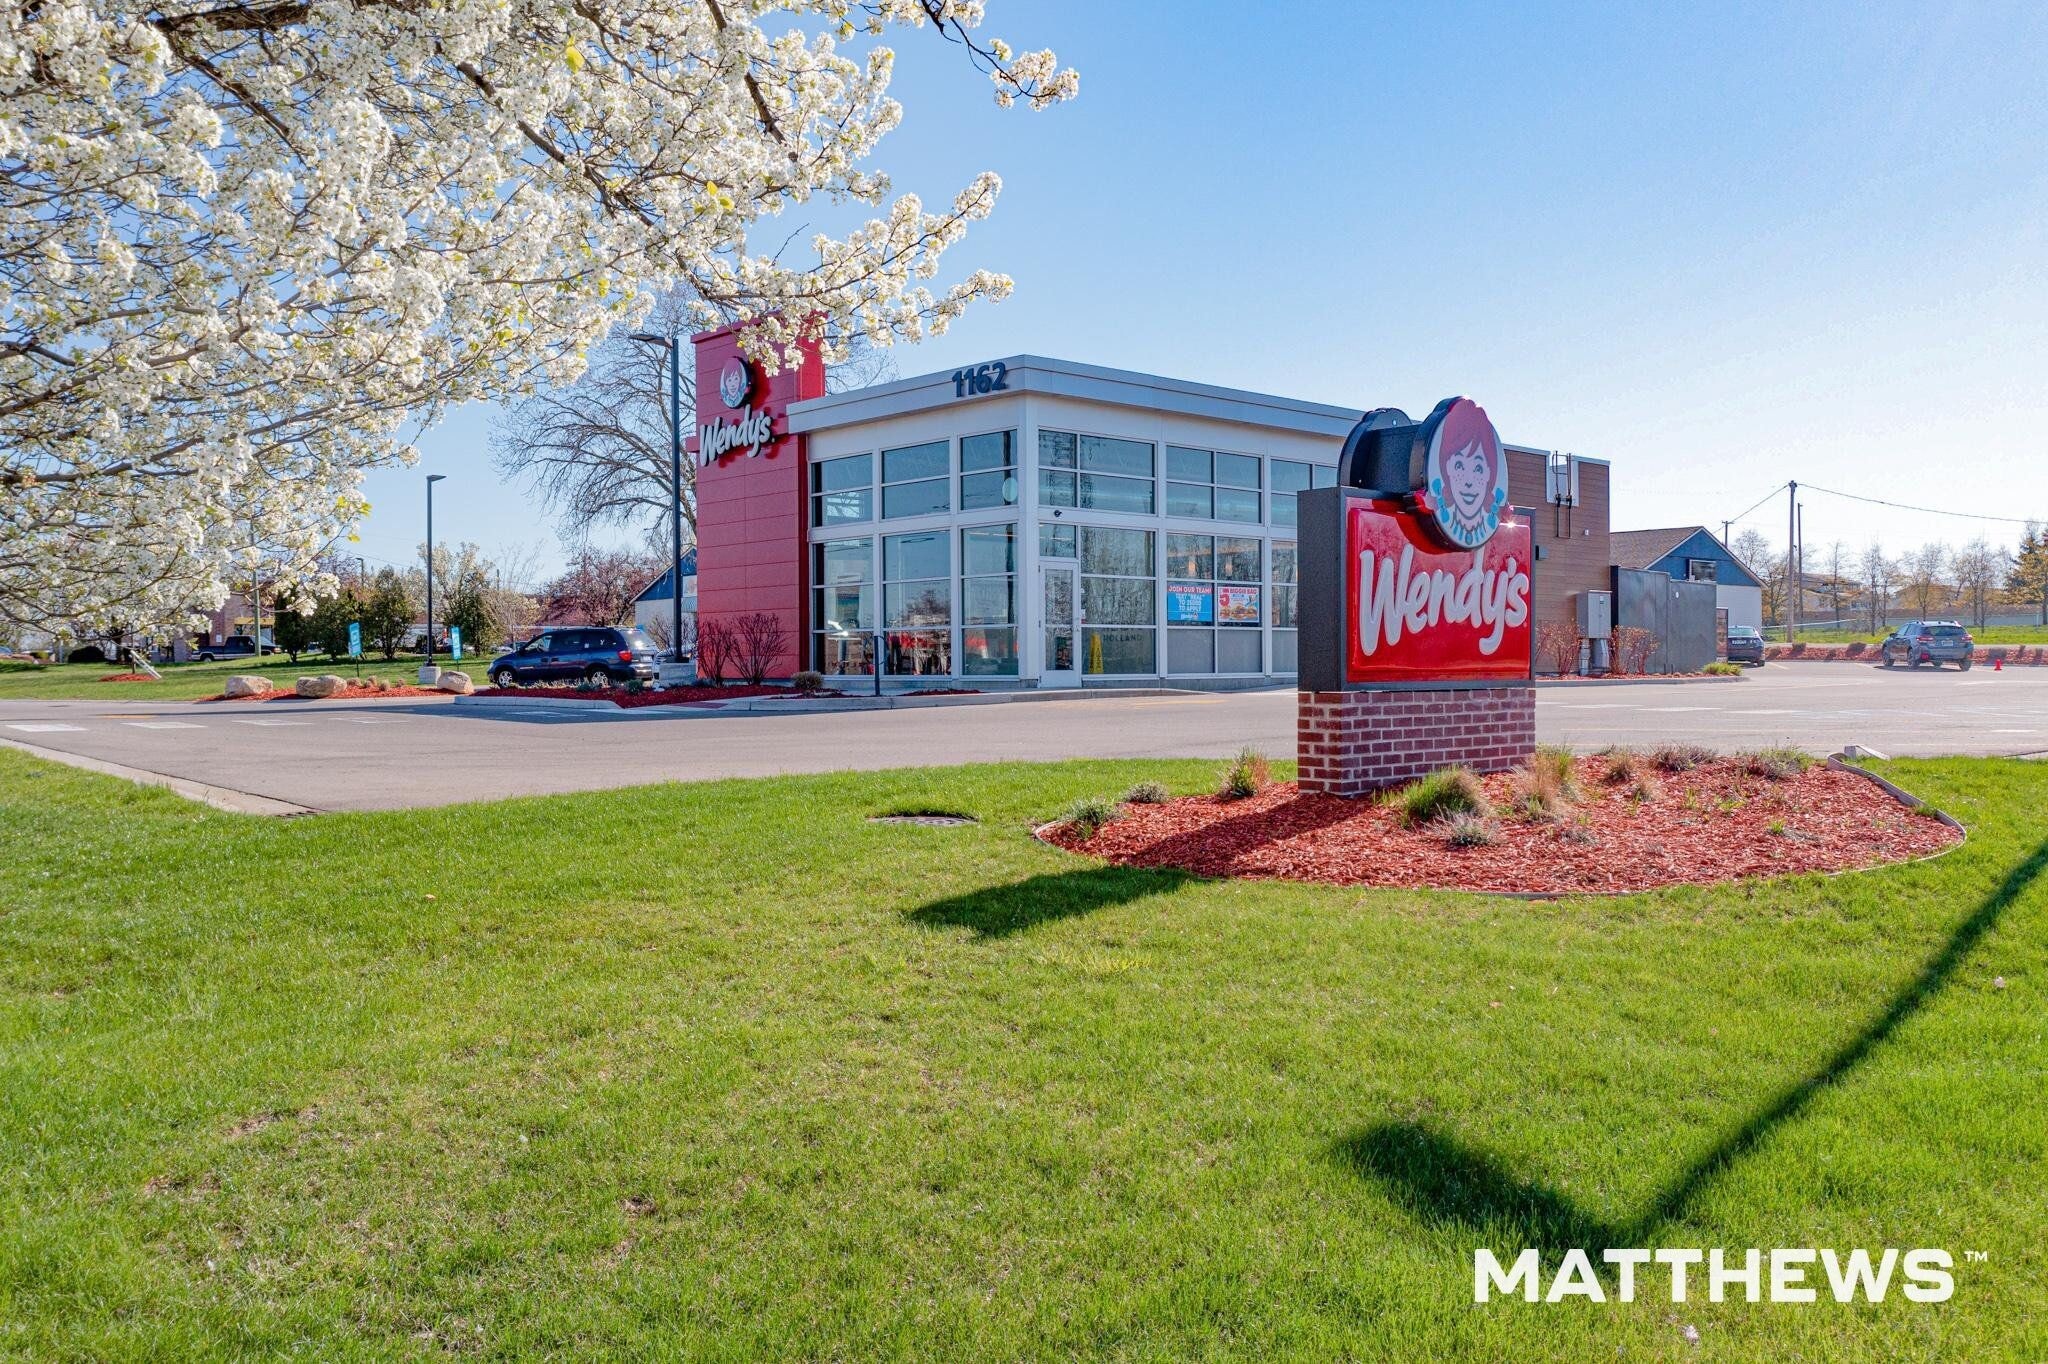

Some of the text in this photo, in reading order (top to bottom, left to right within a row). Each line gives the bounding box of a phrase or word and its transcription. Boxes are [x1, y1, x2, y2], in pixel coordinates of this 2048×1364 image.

[952, 361, 1007, 398] 1162
[700, 404, 772, 467] Wendy's
[1359, 543, 1530, 656] Wendy's
